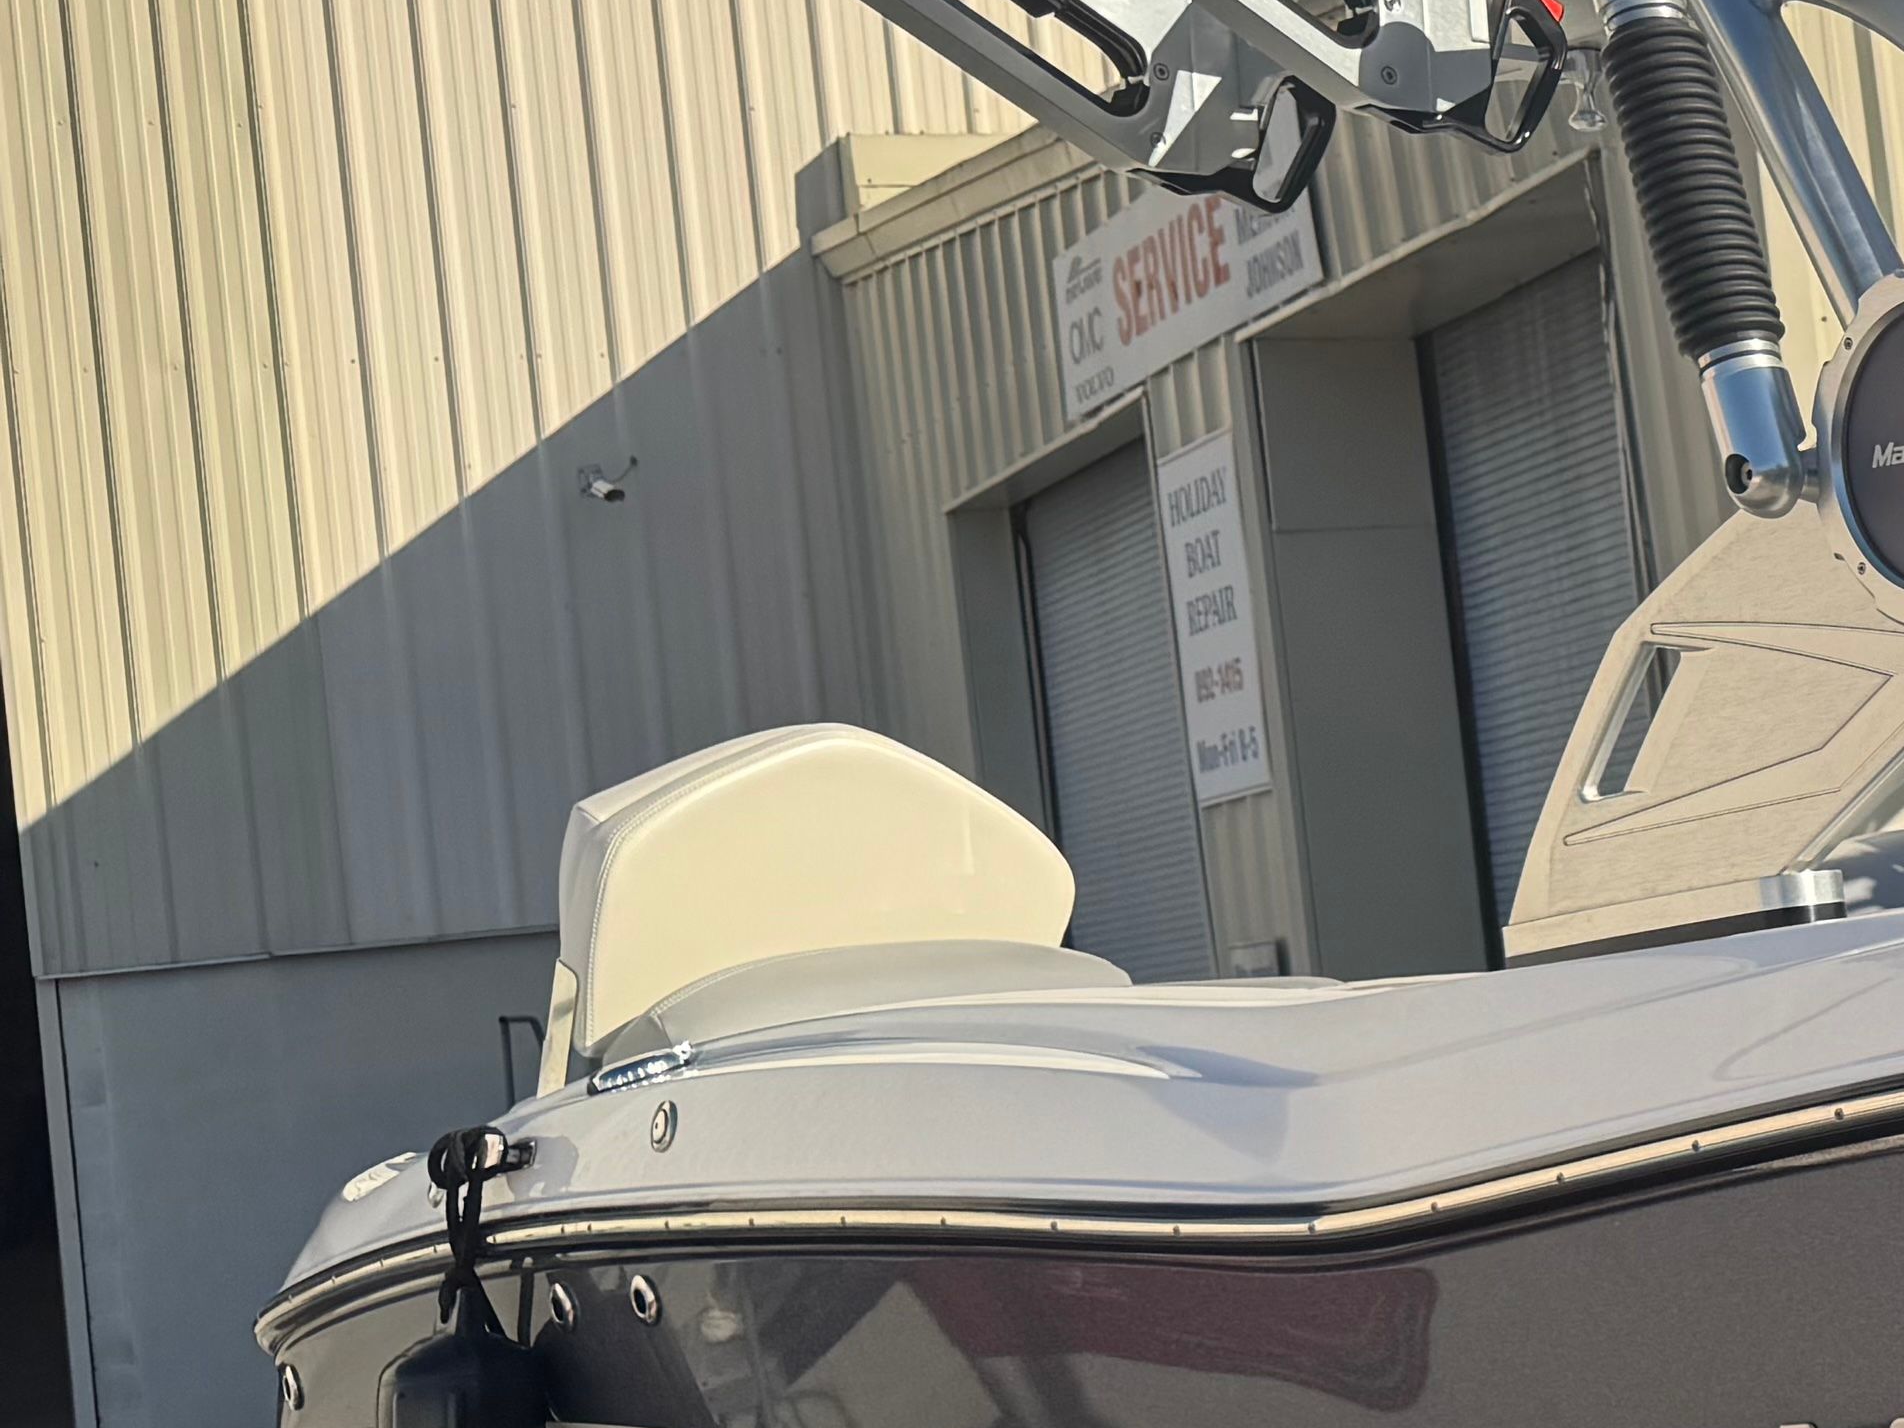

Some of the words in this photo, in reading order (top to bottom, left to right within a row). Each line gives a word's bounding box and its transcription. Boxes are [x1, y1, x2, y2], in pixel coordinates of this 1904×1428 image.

[1112, 194, 1231, 347] SERVICE
[1247, 229, 1304, 300] JOHNSON
[1167, 465, 1227, 527] HOLIDAY
[1184, 529, 1222, 578] BOAT
[1186, 584, 1238, 637] REPAIR
